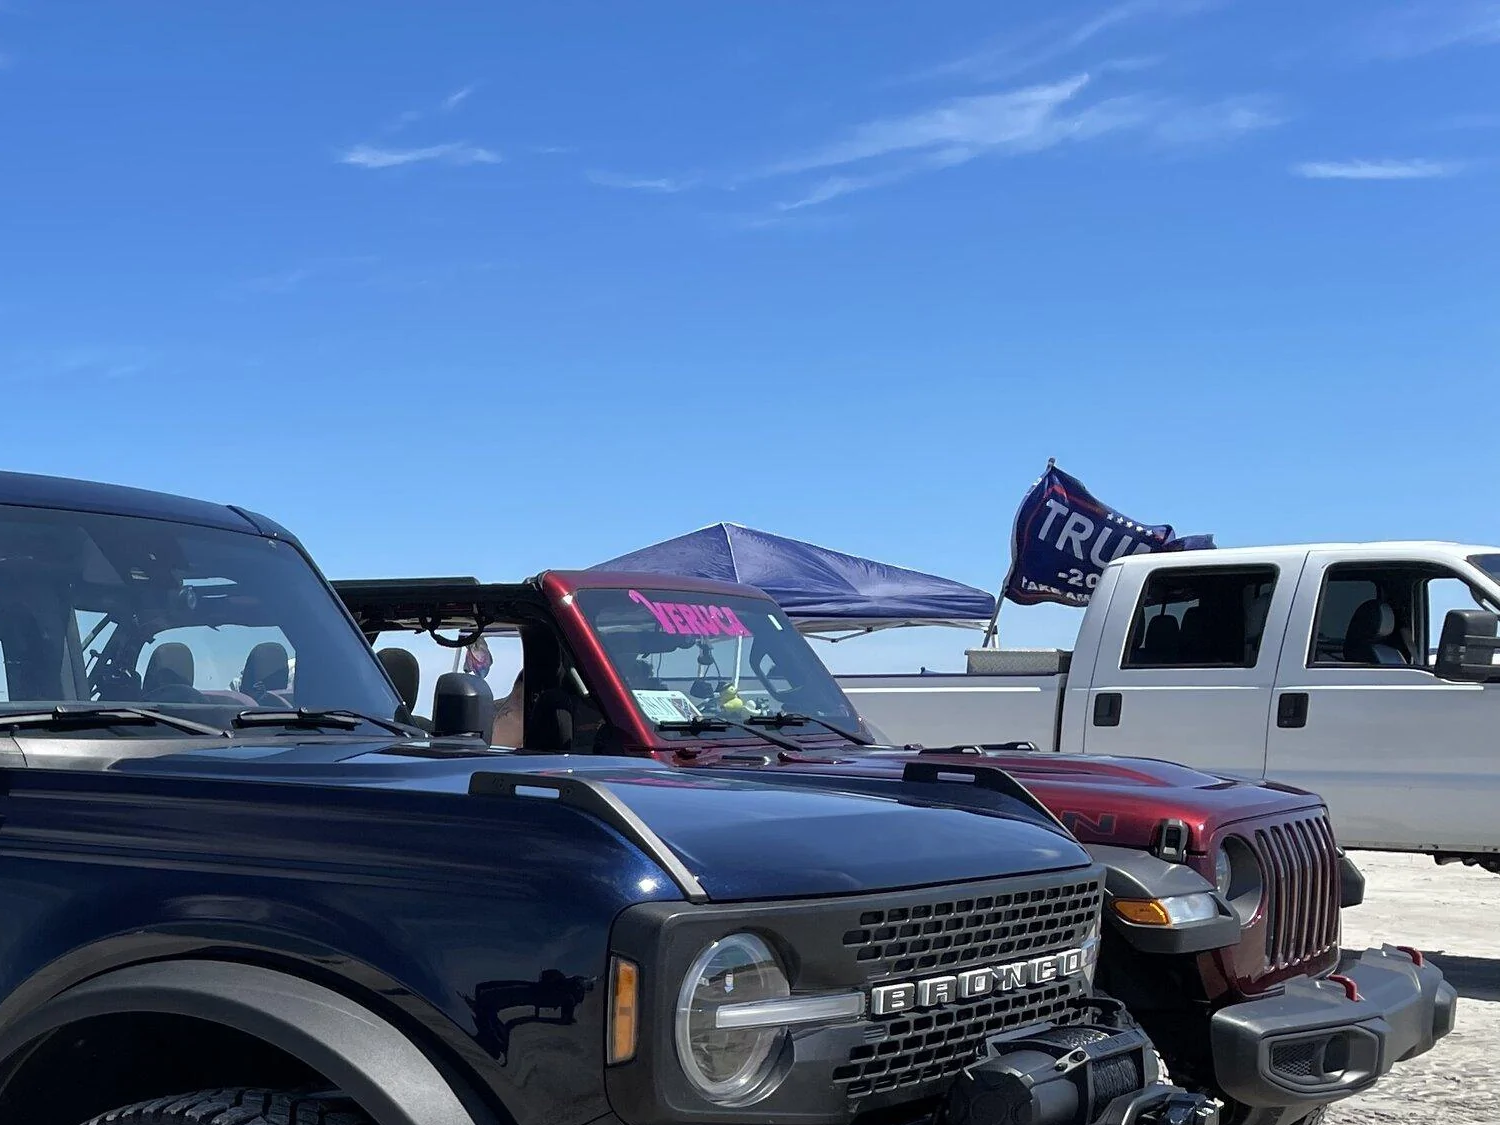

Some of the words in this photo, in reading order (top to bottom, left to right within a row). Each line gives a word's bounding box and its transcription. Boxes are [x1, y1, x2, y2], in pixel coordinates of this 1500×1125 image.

[1037, 498, 1153, 570] TRU
[1057, 568, 1100, 589] -20
[870, 947, 1083, 1016] BRONCO
